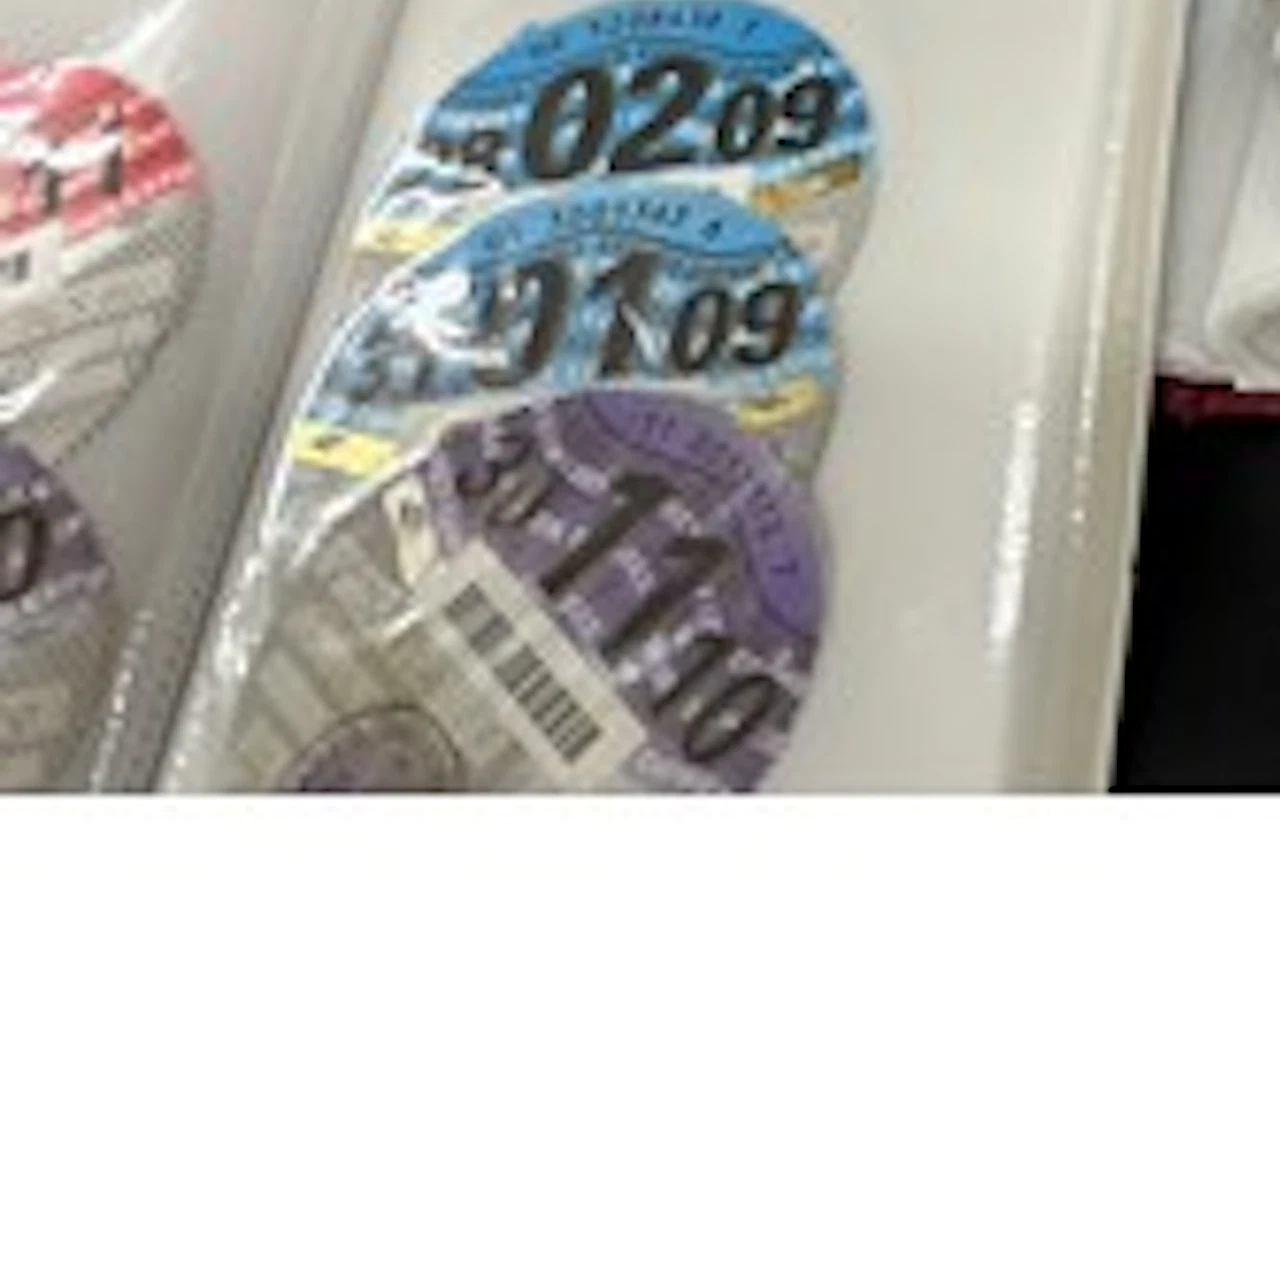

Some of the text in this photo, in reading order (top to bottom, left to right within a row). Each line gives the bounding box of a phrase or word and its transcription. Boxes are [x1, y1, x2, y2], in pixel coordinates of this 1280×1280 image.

[524, 51, 716, 181] 02
[716, 76, 842, 163] 09
[474, 247, 662, 390] 01
[669, 282, 800, 373] 09
[539, 472, 735, 655] 11
[650, 634, 797, 762] 10
